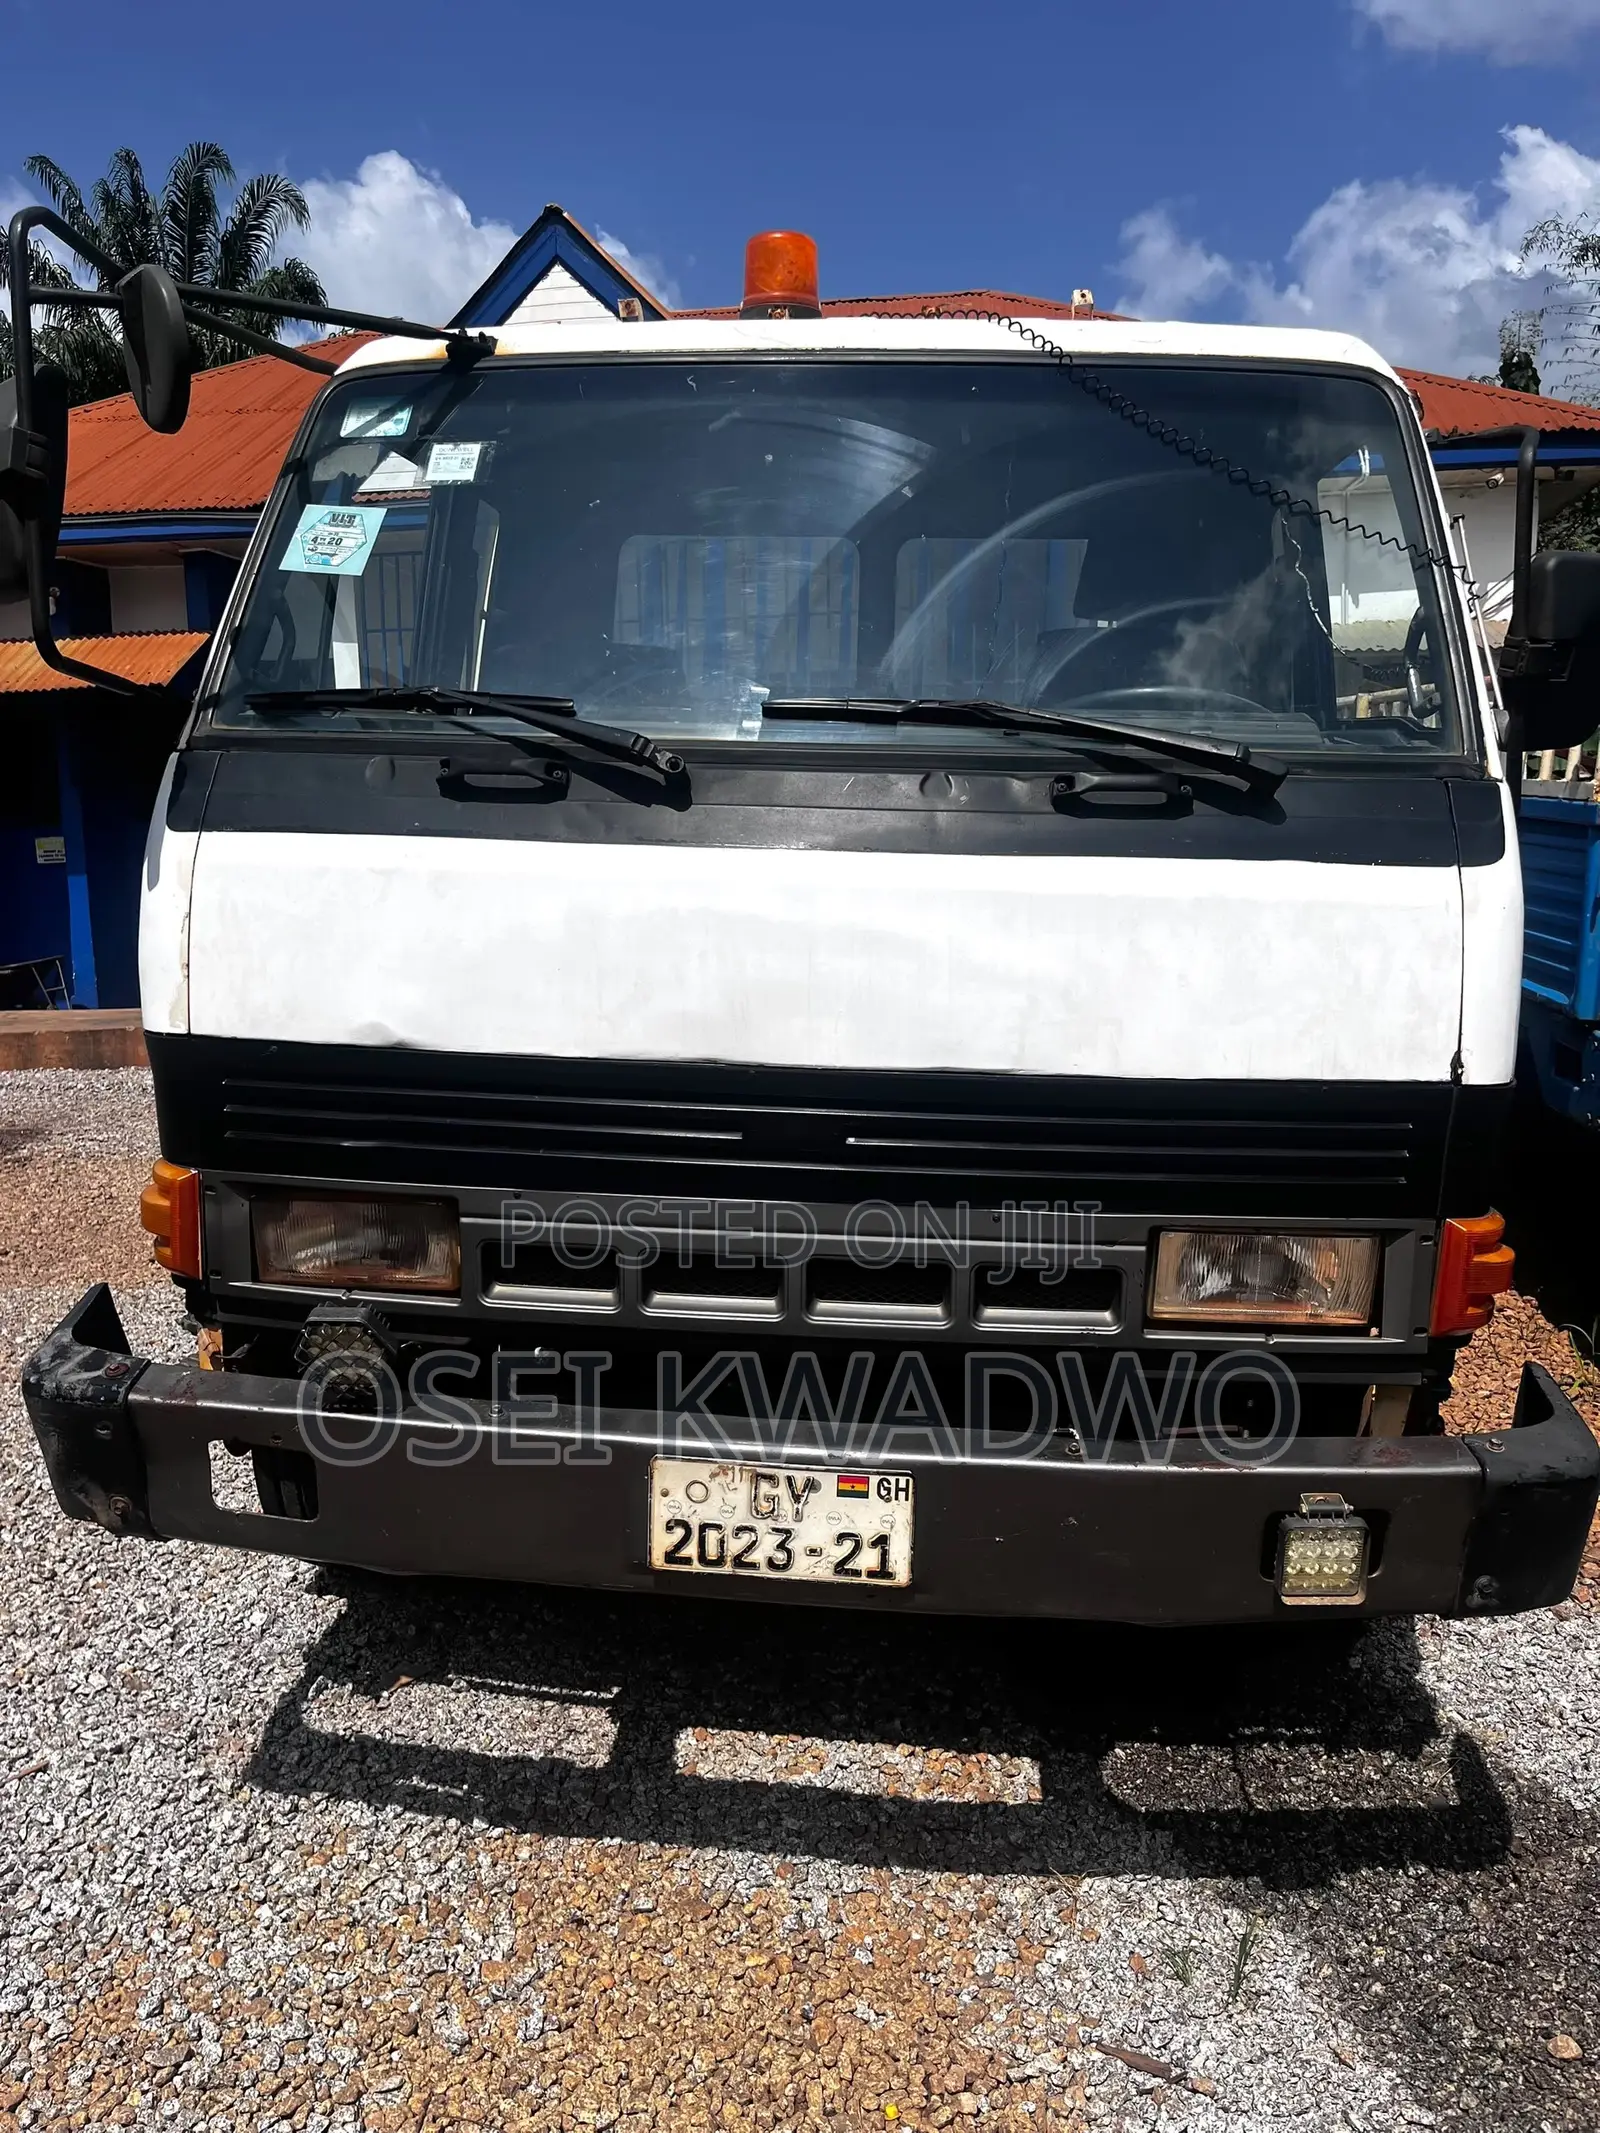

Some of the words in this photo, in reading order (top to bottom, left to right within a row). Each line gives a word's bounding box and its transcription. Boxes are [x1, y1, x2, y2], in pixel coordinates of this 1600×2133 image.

[327, 537, 343, 546] 20
[750, 1472, 815, 1522] GY
[876, 1477, 910, 1503] GH
[663, 1517, 896, 1580] 2023-21
